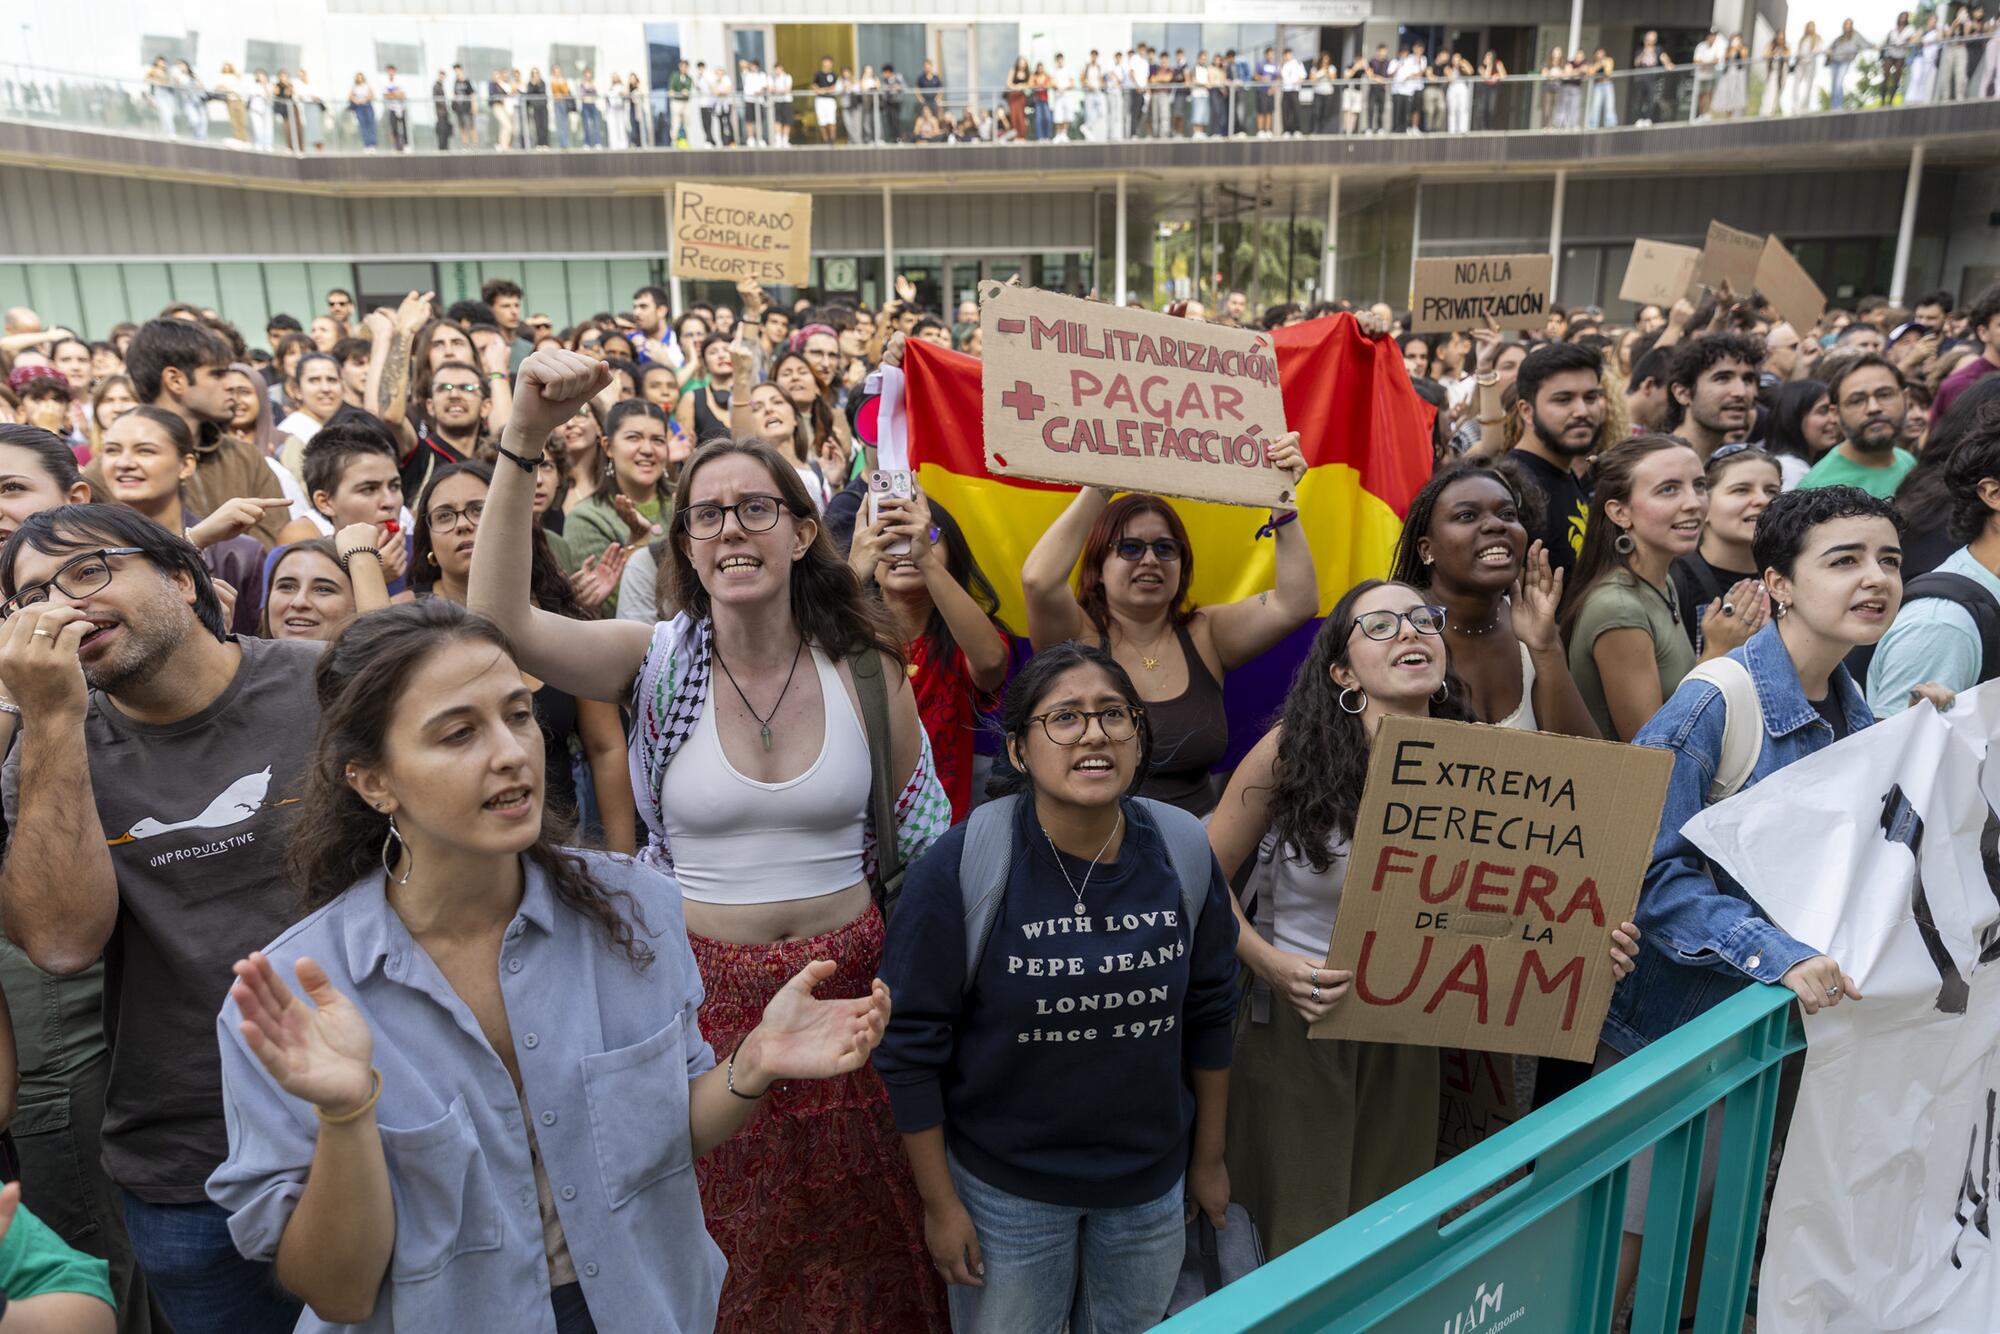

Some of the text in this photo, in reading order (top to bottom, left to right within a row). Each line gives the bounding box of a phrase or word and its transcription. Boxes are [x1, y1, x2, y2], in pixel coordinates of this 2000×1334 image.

[682, 190, 794, 231] RECTORADO
[678, 224, 772, 250] CÓMPLICE
[680, 246, 785, 280] RECORTES
[1455, 262, 1477, 284] NO
[1493, 261, 1512, 282] LA
[1422, 286, 1543, 321] PRIVATIZACIÓN
[1070, 369, 1244, 429] PAGAR
[1392, 740, 1576, 811] EXTREMA
[1382, 802, 1585, 858] DERECHA
[150, 832, 255, 867] UNPRODUCKTIVE
[1371, 846, 1606, 928] FUERA
[1021, 911, 1178, 940] WITH LOVE
[1415, 912, 1553, 944] DE LA
[1007, 939, 1184, 977] PEPE JEANS
[1354, 931, 1586, 1031] UAM
[1036, 985, 1168, 1015] LONDON
[1018, 1015, 1175, 1043] since 1973
